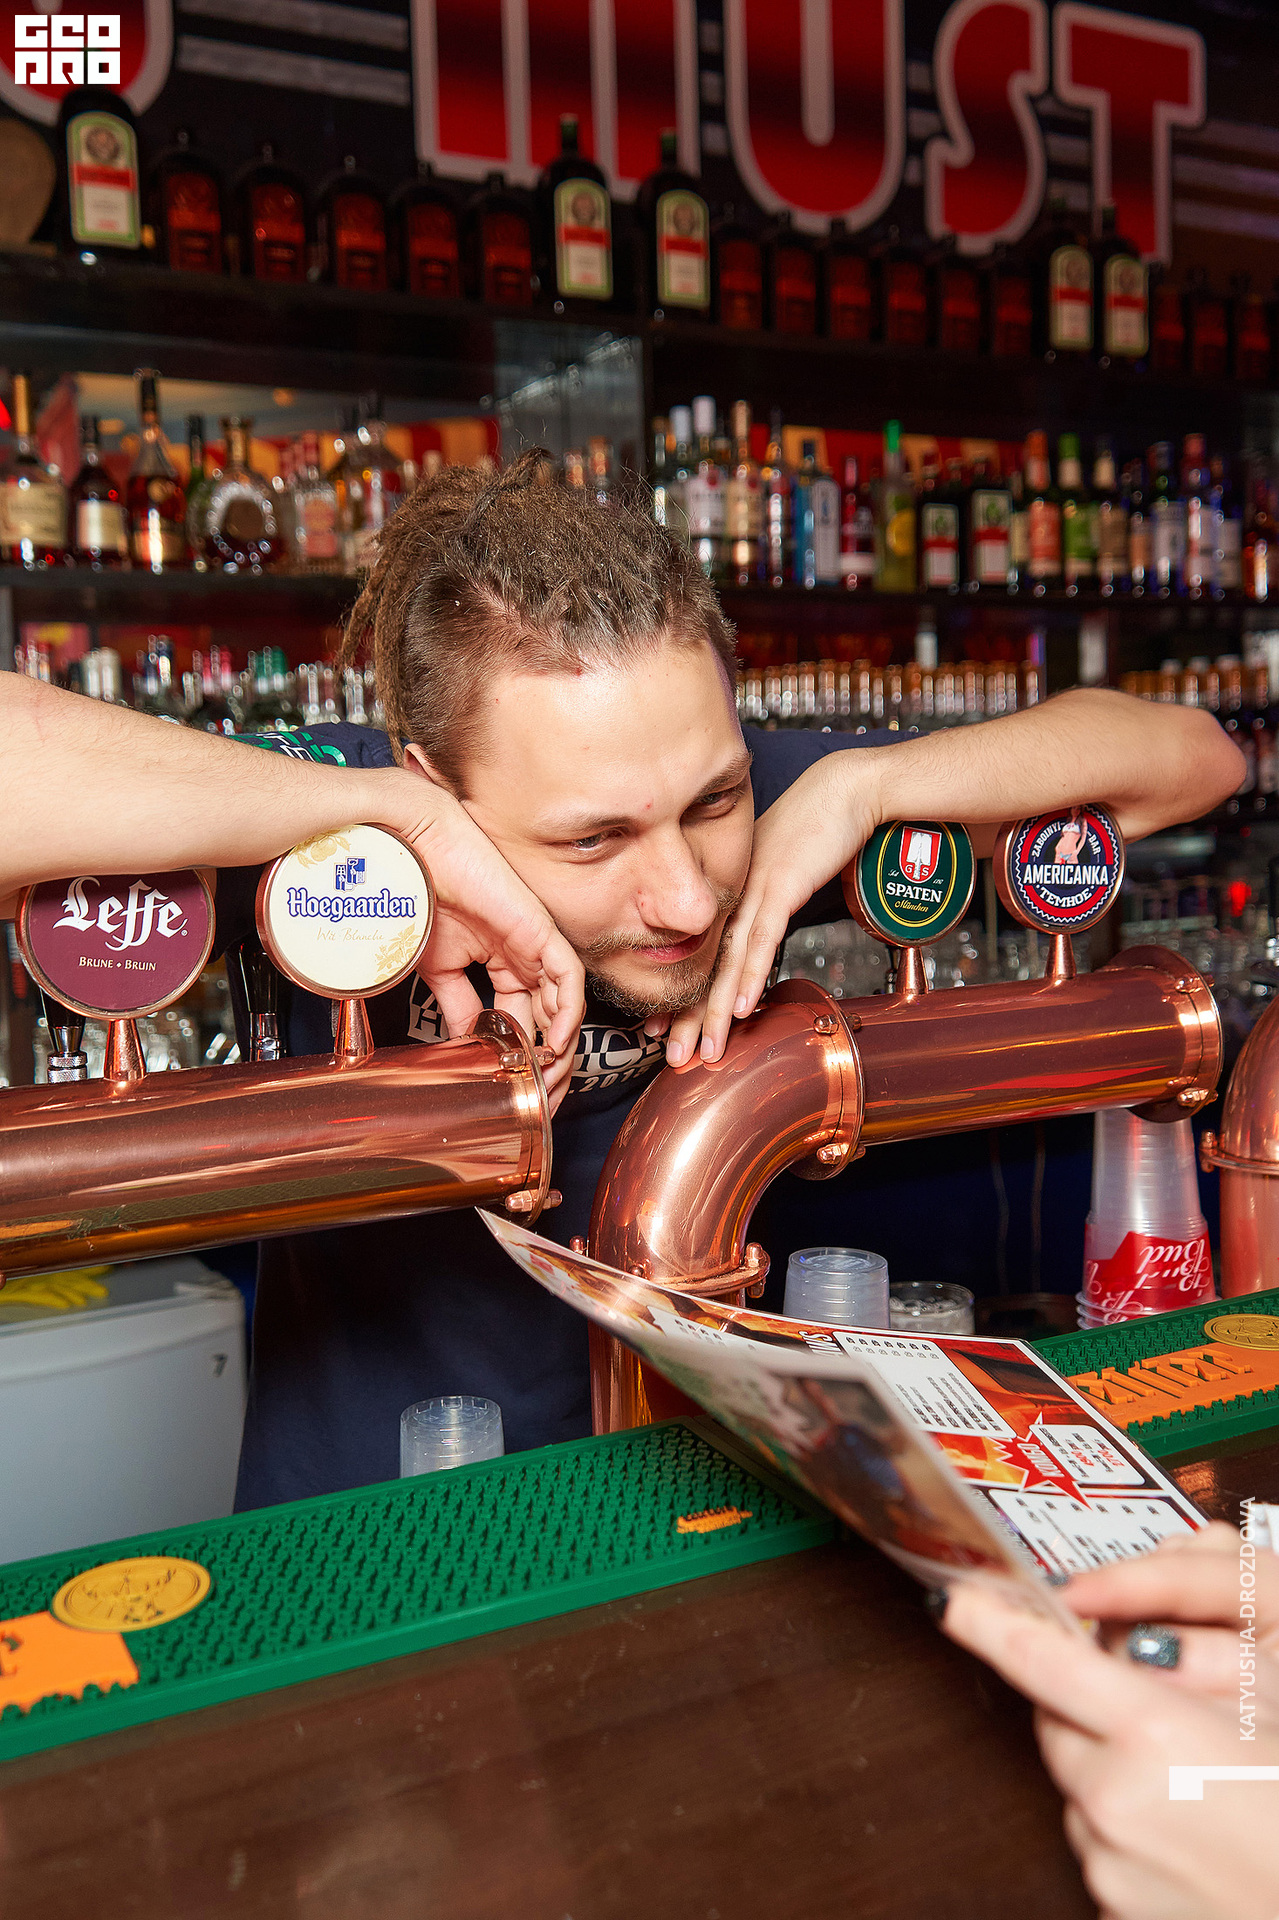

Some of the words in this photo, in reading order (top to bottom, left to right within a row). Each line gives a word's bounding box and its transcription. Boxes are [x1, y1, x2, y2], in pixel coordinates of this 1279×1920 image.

[1031, 821, 1062, 858] ZABOINYI
[1088, 833, 1101, 855] BAR
[1023, 864, 1109, 885] AMERICANKA
[287, 887, 416, 923] Hoegaarden
[886, 882, 943, 903] SPATEN
[1039, 887, 1093, 908] ТЕМНОЕ
[52, 876, 188, 951] Leffe
[316, 927, 336, 941] Wit
[341, 927, 385, 941] Blanche
[1136, 1239, 1210, 1275] Bud
